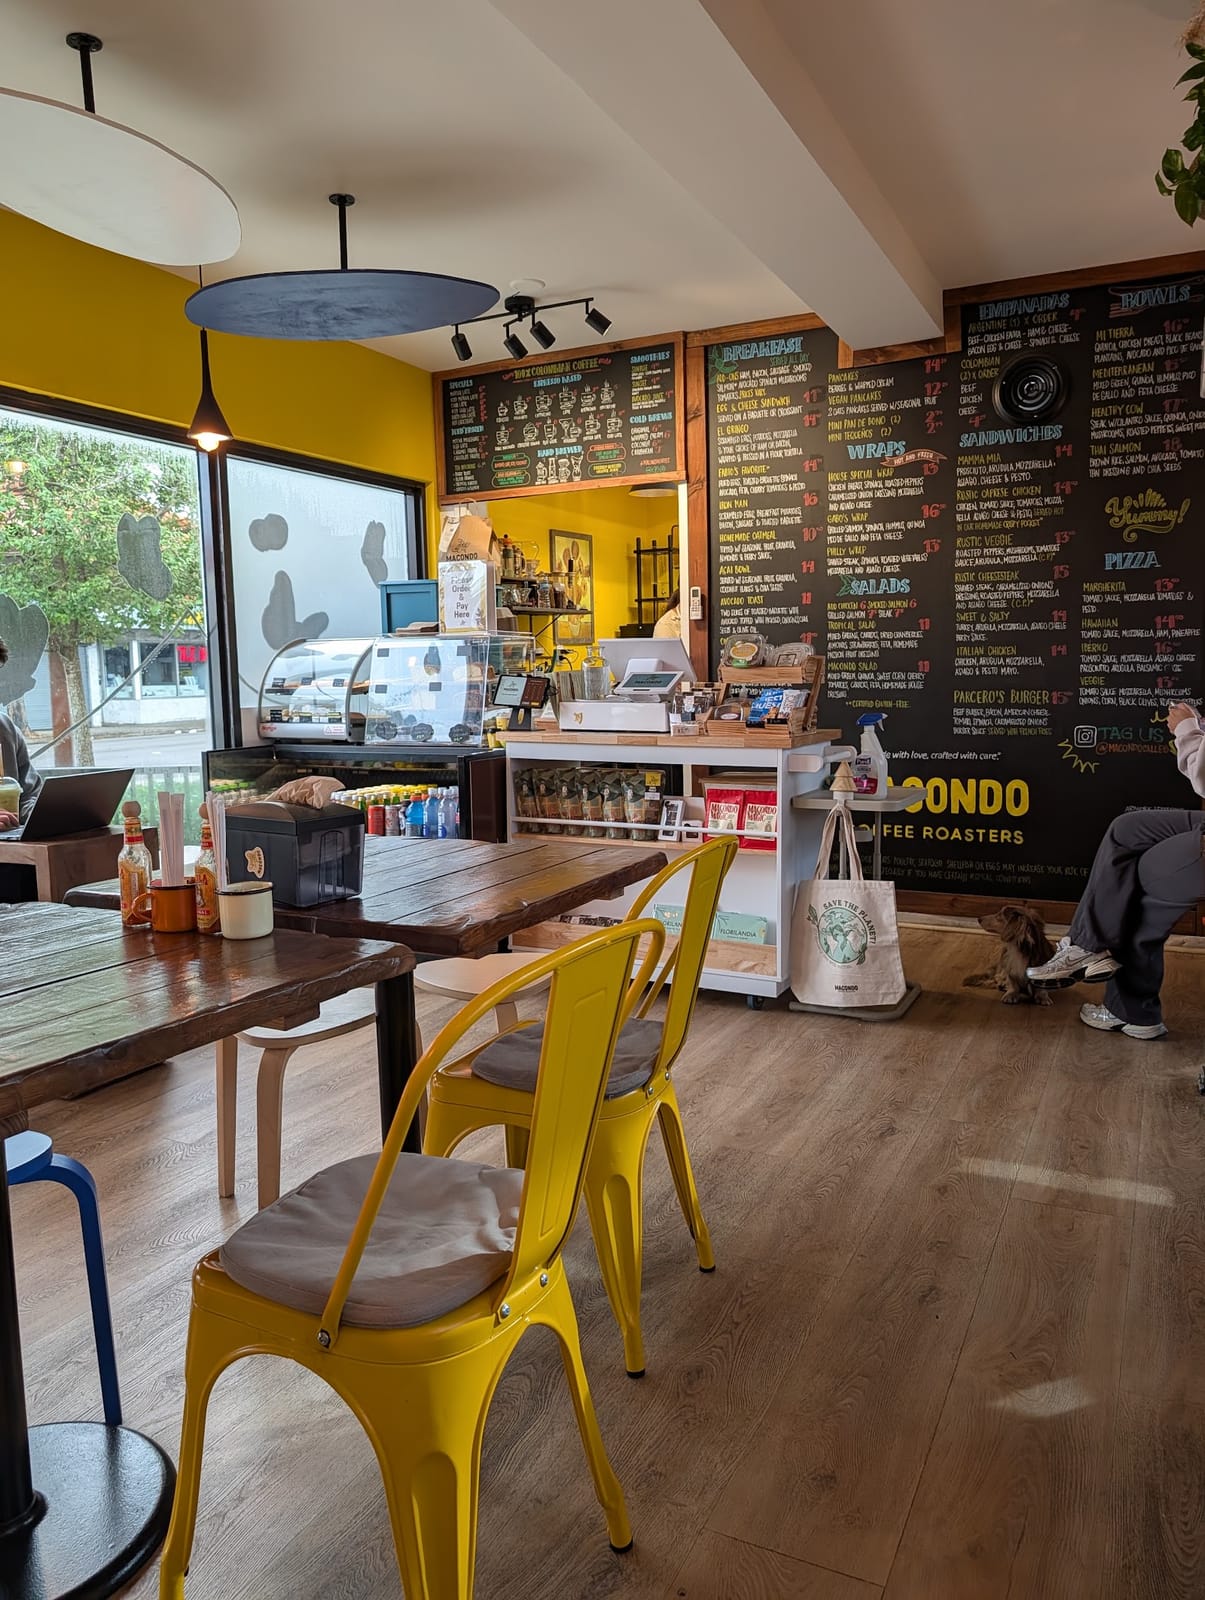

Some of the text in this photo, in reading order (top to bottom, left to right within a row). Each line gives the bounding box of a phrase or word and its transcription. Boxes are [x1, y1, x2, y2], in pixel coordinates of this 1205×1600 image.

[1120, 285, 1190, 309] BOWLS
[1108, 326, 1135, 338] TIERRA
[724, 337, 803, 361] BREAKFAST
[573, 357, 599, 370] COFFEE
[828, 371, 859, 383] PANCAKES
[877, 377, 894, 387] CREAM
[960, 383, 977, 394] BEEF
[738, 401, 758, 411] CHEESE
[761, 396, 790, 408] SANDWICH
[828, 391, 881, 405] VEGAN PANCAKES
[960, 393, 983, 404] CHICKEN
[1092, 402, 1144, 417] HEALTHY COW
[630, 414, 647, 424] COLD
[828, 421, 841, 431] MINI
[858, 419, 865, 427] DE
[717, 424, 749, 436] EL GRINGO
[959, 424, 1063, 448] SANDWICHES
[828, 432, 841, 443] MINI
[847, 441, 906, 460] WRAPS
[1090, 442, 1142, 455] THAI SALMON
[958, 453, 1002, 465] MAMMA MIA
[828, 468, 895, 482] HOUSE SPECIAL WRAP
[956, 490, 978, 501] RUSTIC
[1012, 485, 1041, 496] CHICKEN
[735, 500, 748, 508] MAN
[851, 513, 868, 521] WRAP
[720, 531, 776, 542] HOMEMADE OATMEAL
[956, 533, 1014, 548] RUSTIC VEGGIE
[446, 552, 478, 562] MACONDO
[827, 546, 867, 556] PHILLY WRAP
[1104, 550, 1161, 570] PIZZA
[955, 570, 1019, 582] RUSTIC CHEESESTEAK
[850, 578, 910, 595] SALADS
[1083, 581, 1126, 592] MARGHERITA
[456, 602, 468, 611] Pay
[721, 596, 764, 606] AVOCADO TOAST
[838, 601, 858, 609] CHICKEN
[860, 600, 867, 609] 6
[888, 599, 908, 609] SALMON
[909, 598, 917, 608] 6
[454, 610, 470, 618] Here
[956, 611, 1010, 622] SWEET SALTY
[828, 620, 876, 631] TROPICAL SALAD
[1081, 618, 1119, 629] HAWAIIAN
[957, 645, 1017, 656] ITALIAN CHICKEN
[827, 662, 878, 671] MACONDO SALAD
[1080, 676, 1105, 686] VEGGIE
[1011, 689, 1050, 704] BURGER
[1098, 726, 1164, 742] TAG US
[892, 751, 977, 760] with love, crafted with
[886, 776, 1030, 817] ONDO
[923, 827, 1024, 845] ROASTERS
[823, 900, 842, 910] SAVE
[844, 901, 859, 912] THE
